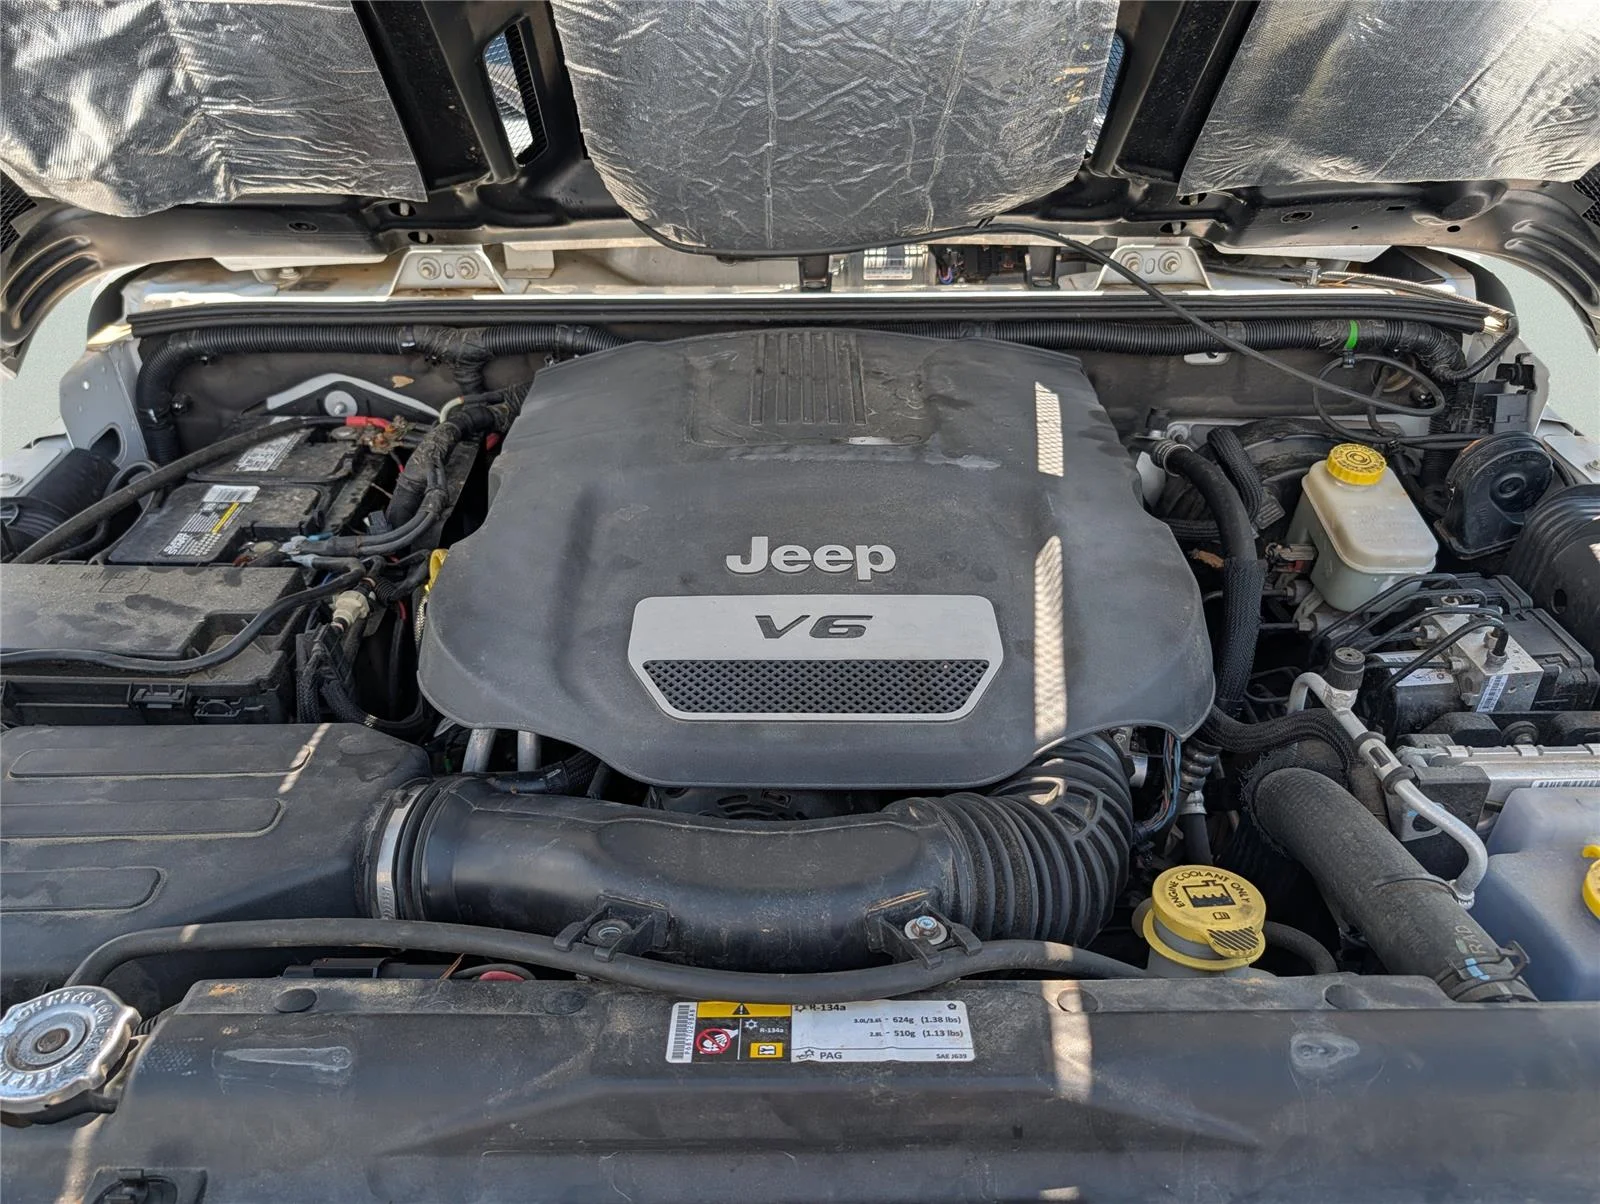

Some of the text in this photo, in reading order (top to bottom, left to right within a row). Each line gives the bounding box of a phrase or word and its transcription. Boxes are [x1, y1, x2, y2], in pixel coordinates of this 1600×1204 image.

[726, 536, 896, 582] Jeep
[755, 615, 873, 639] V6
[1168, 870, 1251, 908] ENGINE COOLANT ONLY
[1454, 925, 1487, 954] RAD
[91, 999, 114, 1023] NOT
[809, 1004, 847, 1012] R-134a
[892, 1016, 914, 1025] 624g
[920, 1016, 944, 1025] (1.38
[945, 1016, 962, 1025] lbs)
[893, 1029, 916, 1038] 510g
[922, 1029, 946, 1038] (1.13
[947, 1029, 964, 1038] lbs)
[819, 1051, 843, 1060] PAG
